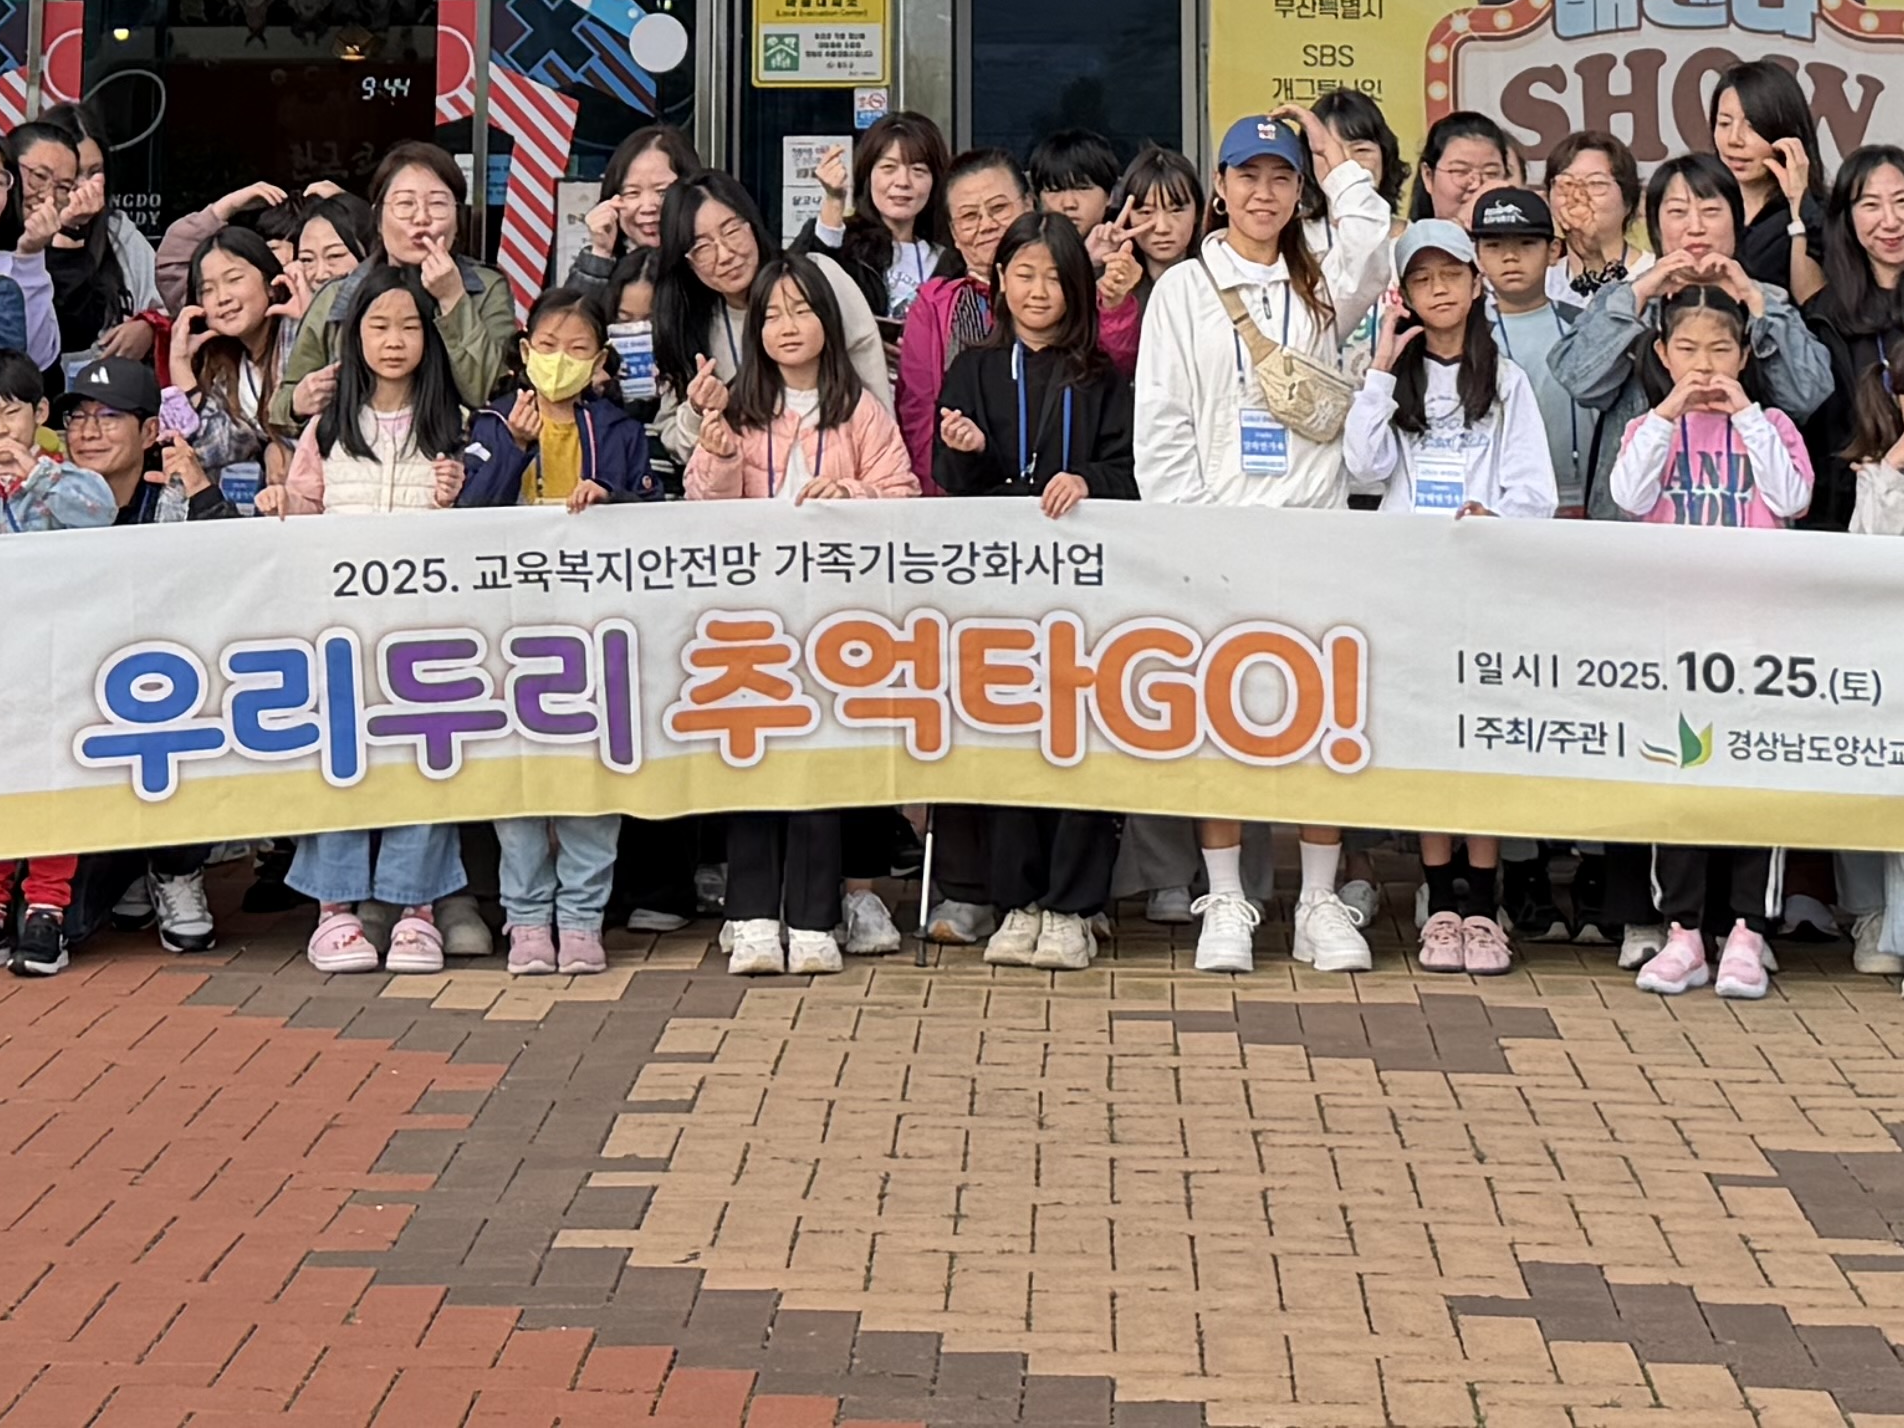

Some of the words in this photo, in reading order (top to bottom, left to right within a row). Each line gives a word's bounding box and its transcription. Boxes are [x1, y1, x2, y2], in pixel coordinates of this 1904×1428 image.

[1302, 44, 1355, 68] SBS
[332, 560, 459, 597] 2025.
[472, 542, 760, 593] 교육복지안전망
[774, 540, 1105, 587] 가족기능강화사업
[1576, 659, 1669, 692] 2025.
[80, 619, 634, 796] 우리두리
[665, 609, 1372, 772] 추억타GO!
